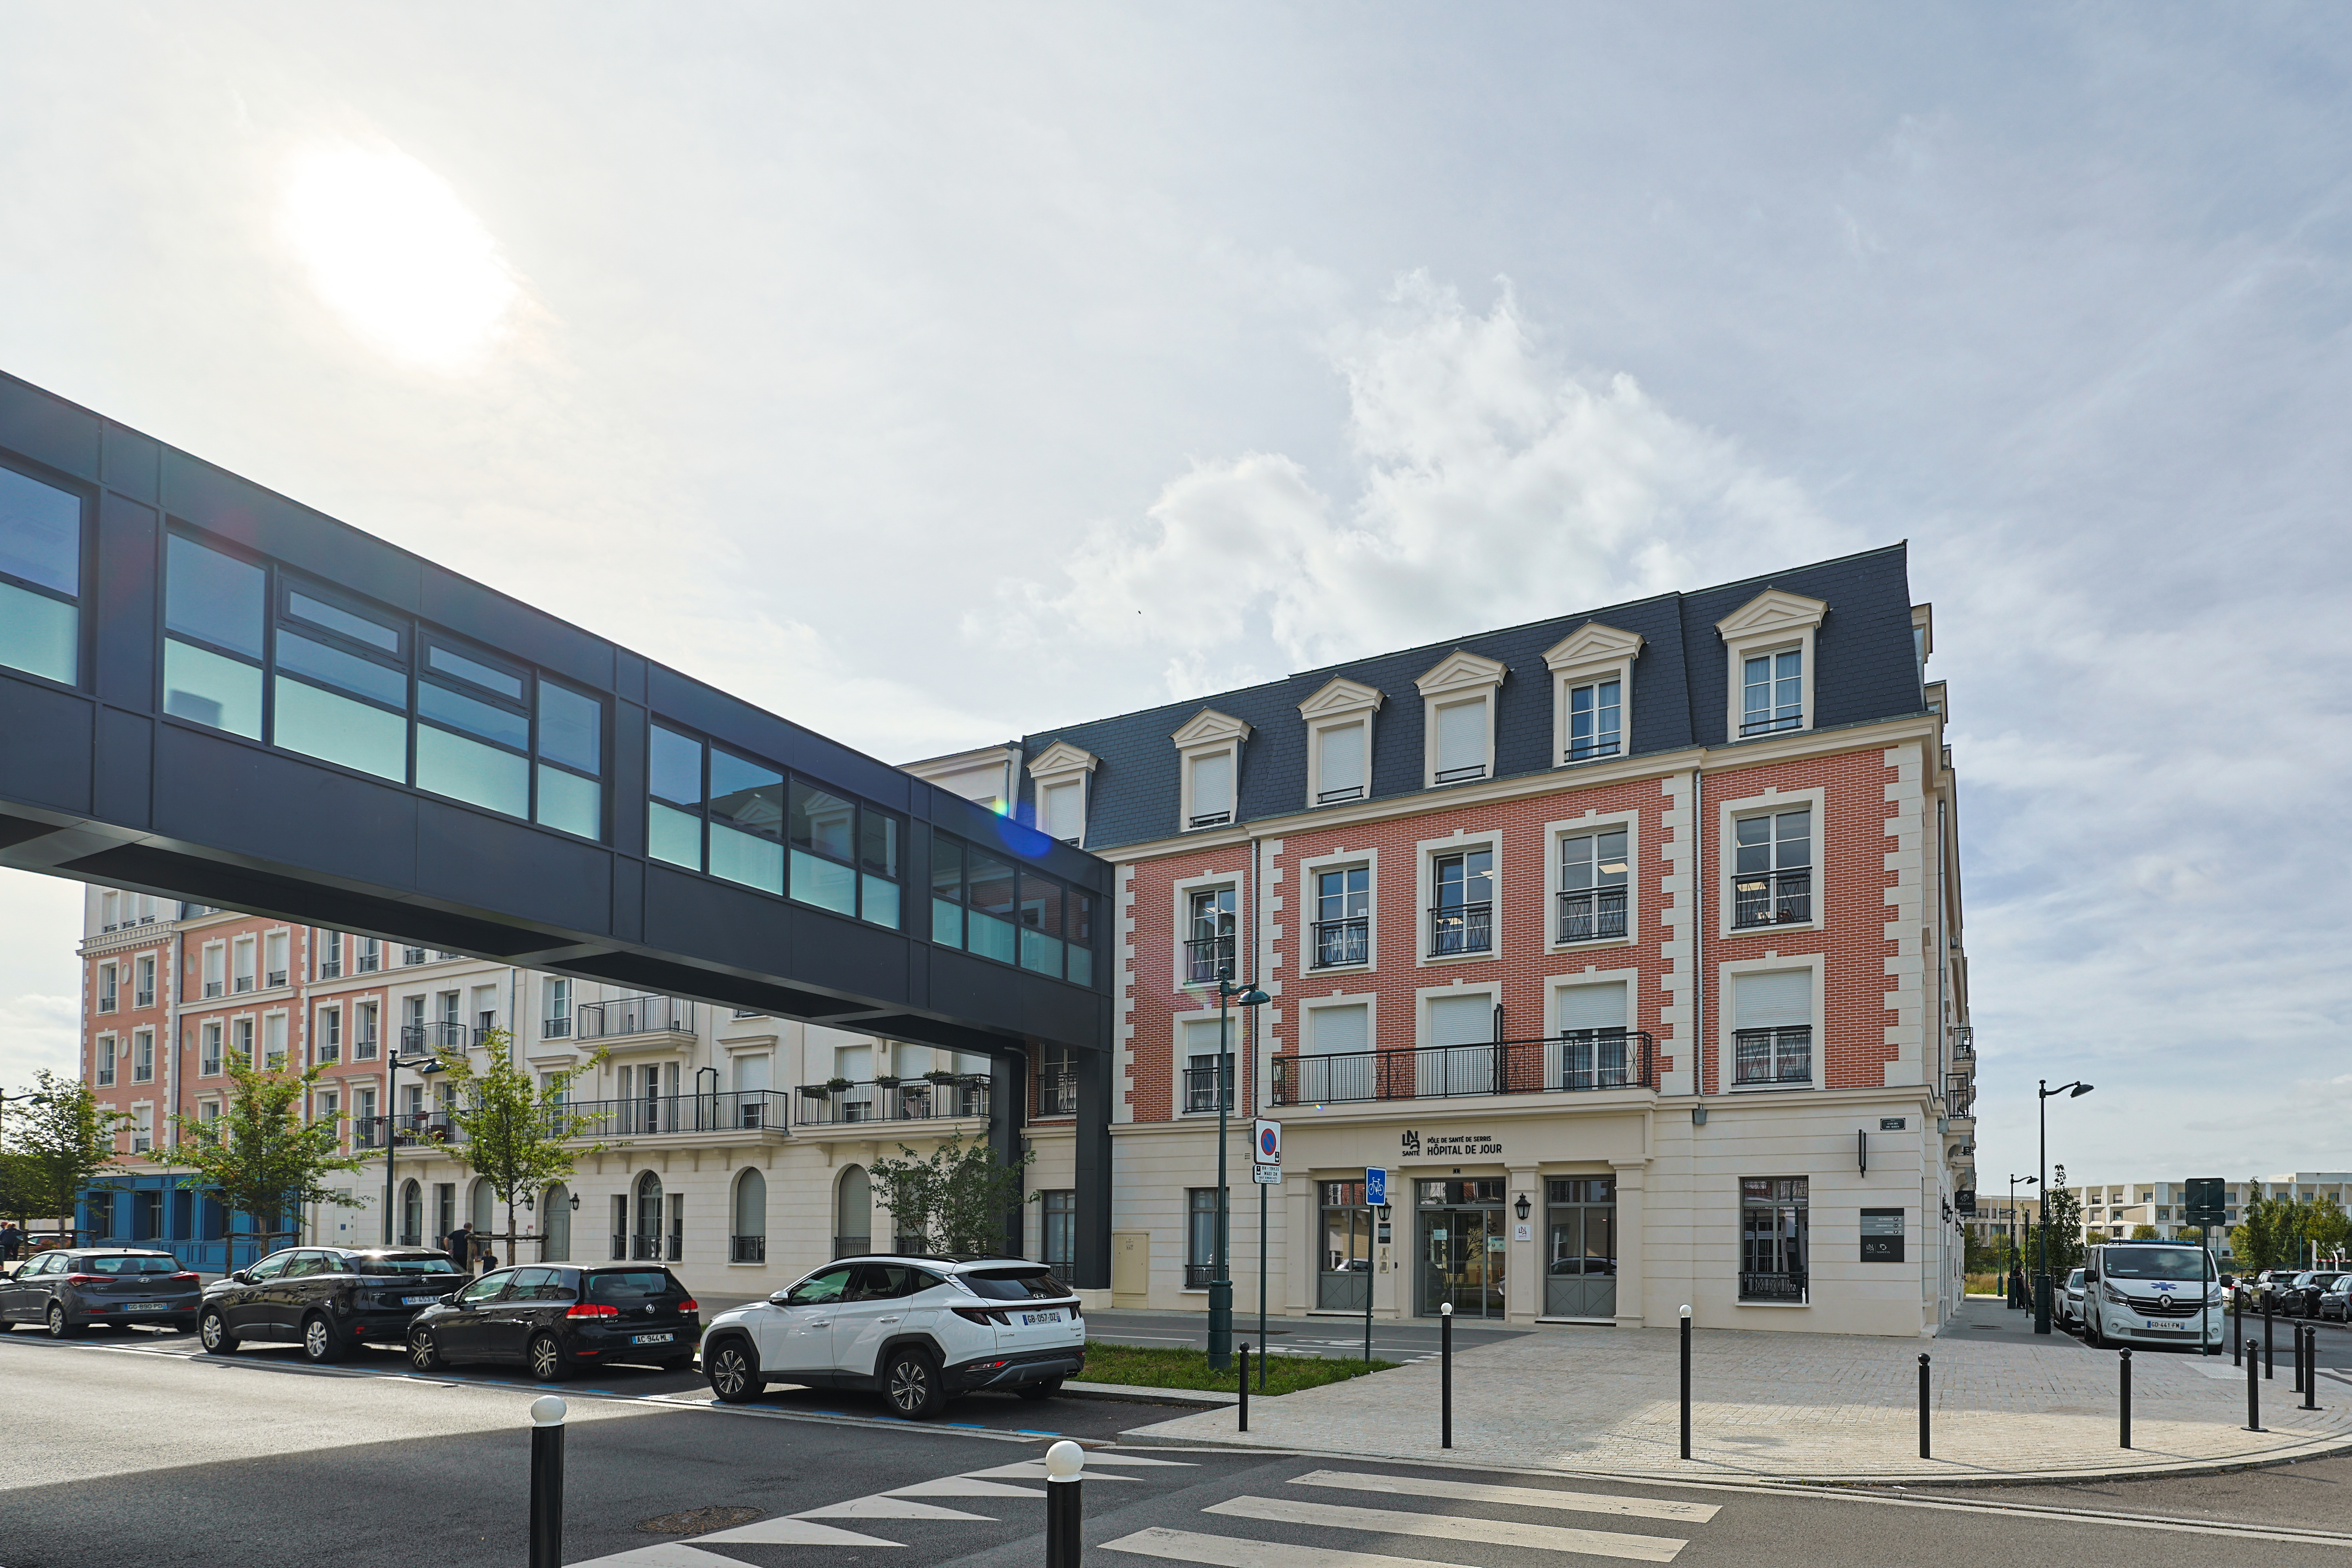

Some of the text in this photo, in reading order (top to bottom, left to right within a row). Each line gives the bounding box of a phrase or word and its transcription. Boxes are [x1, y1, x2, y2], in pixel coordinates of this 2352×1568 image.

[1427, 1144, 1502, 1155] HÔPITAL DE JOUR
[1027, 1313, 1057, 1323] GB-057-DZ
